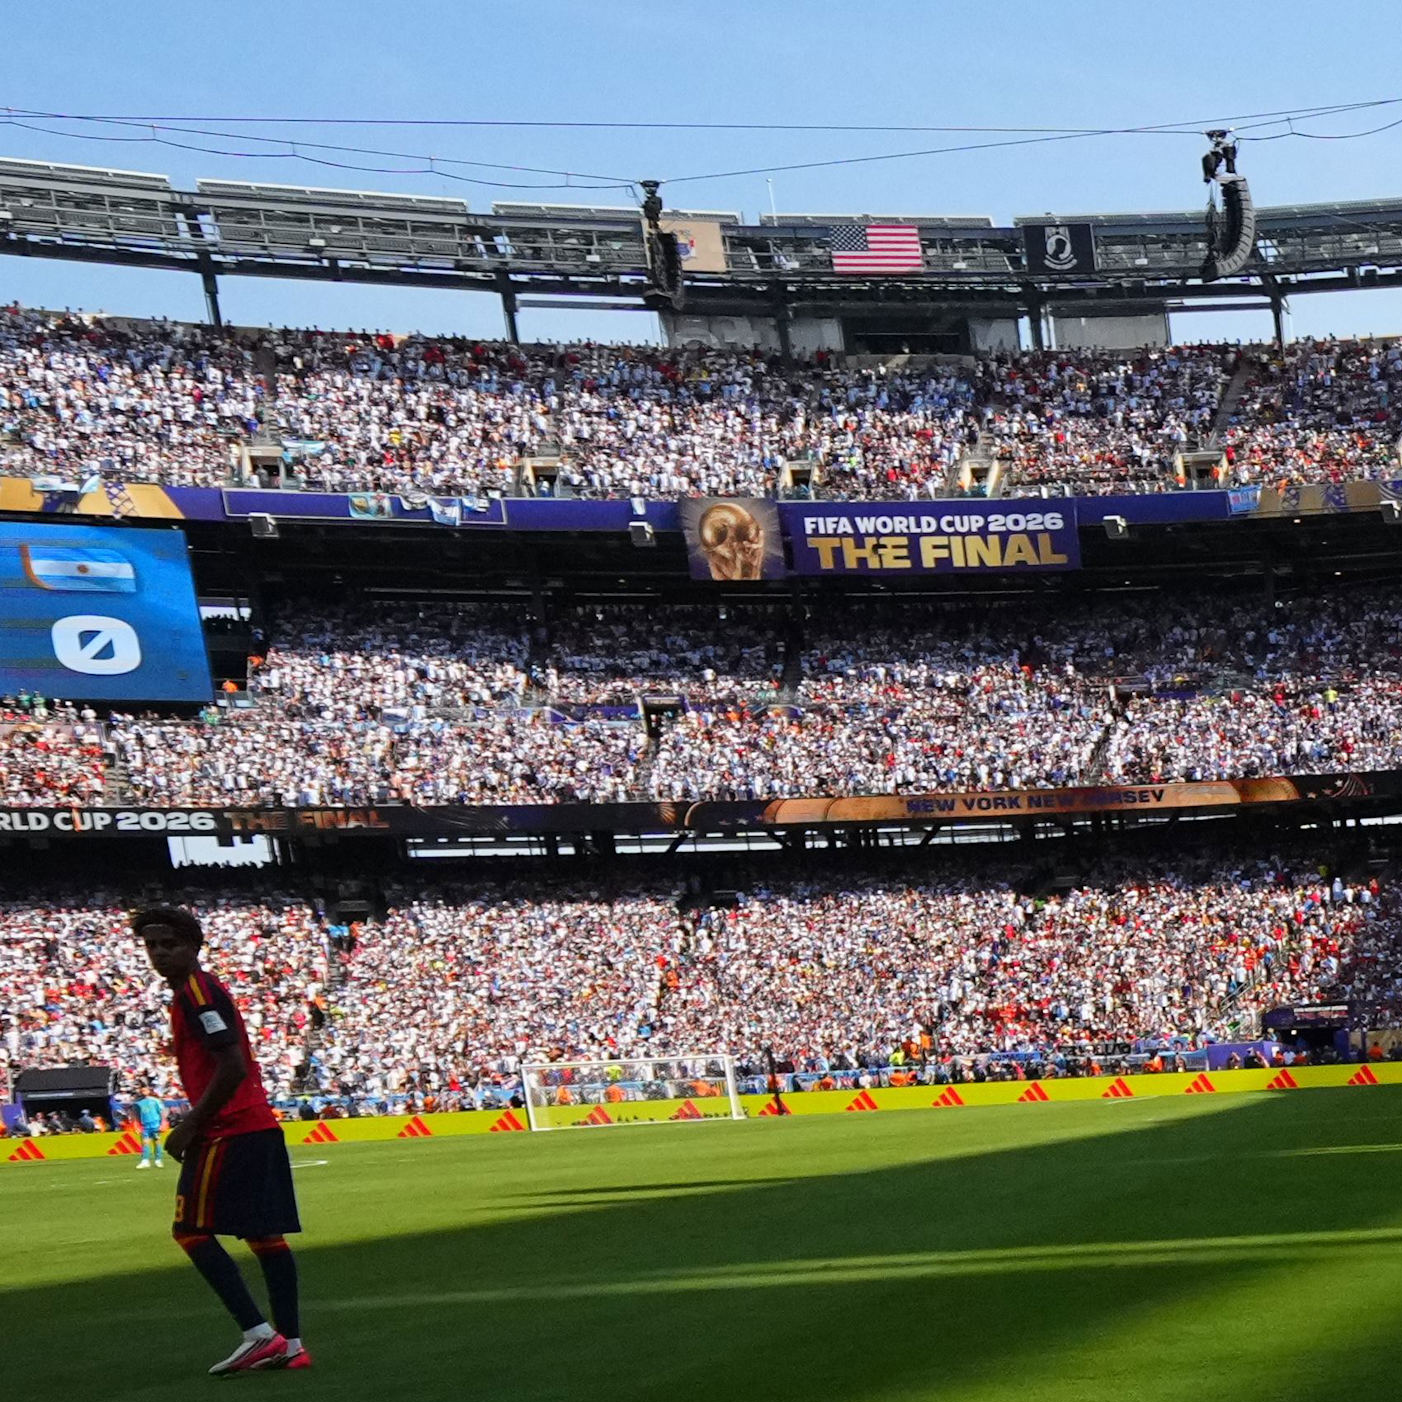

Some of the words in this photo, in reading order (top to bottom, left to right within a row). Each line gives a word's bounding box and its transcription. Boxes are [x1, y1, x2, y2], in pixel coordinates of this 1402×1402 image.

[804, 517, 853, 534] FIFA
[855, 516, 937, 533] WORLD
[940, 515, 984, 532] CUP
[988, 513, 1064, 531] 2026
[807, 537, 912, 569] THE
[919, 533, 1068, 568] FINAL
[52, 615, 141, 675] 0
[907, 799, 955, 813] NEW
[963, 796, 1021, 811] YORK
[54, 812, 111, 830] CUP
[117, 812, 215, 830] 2026
[225, 811, 289, 830] THE
[301, 810, 390, 829] FINAL
